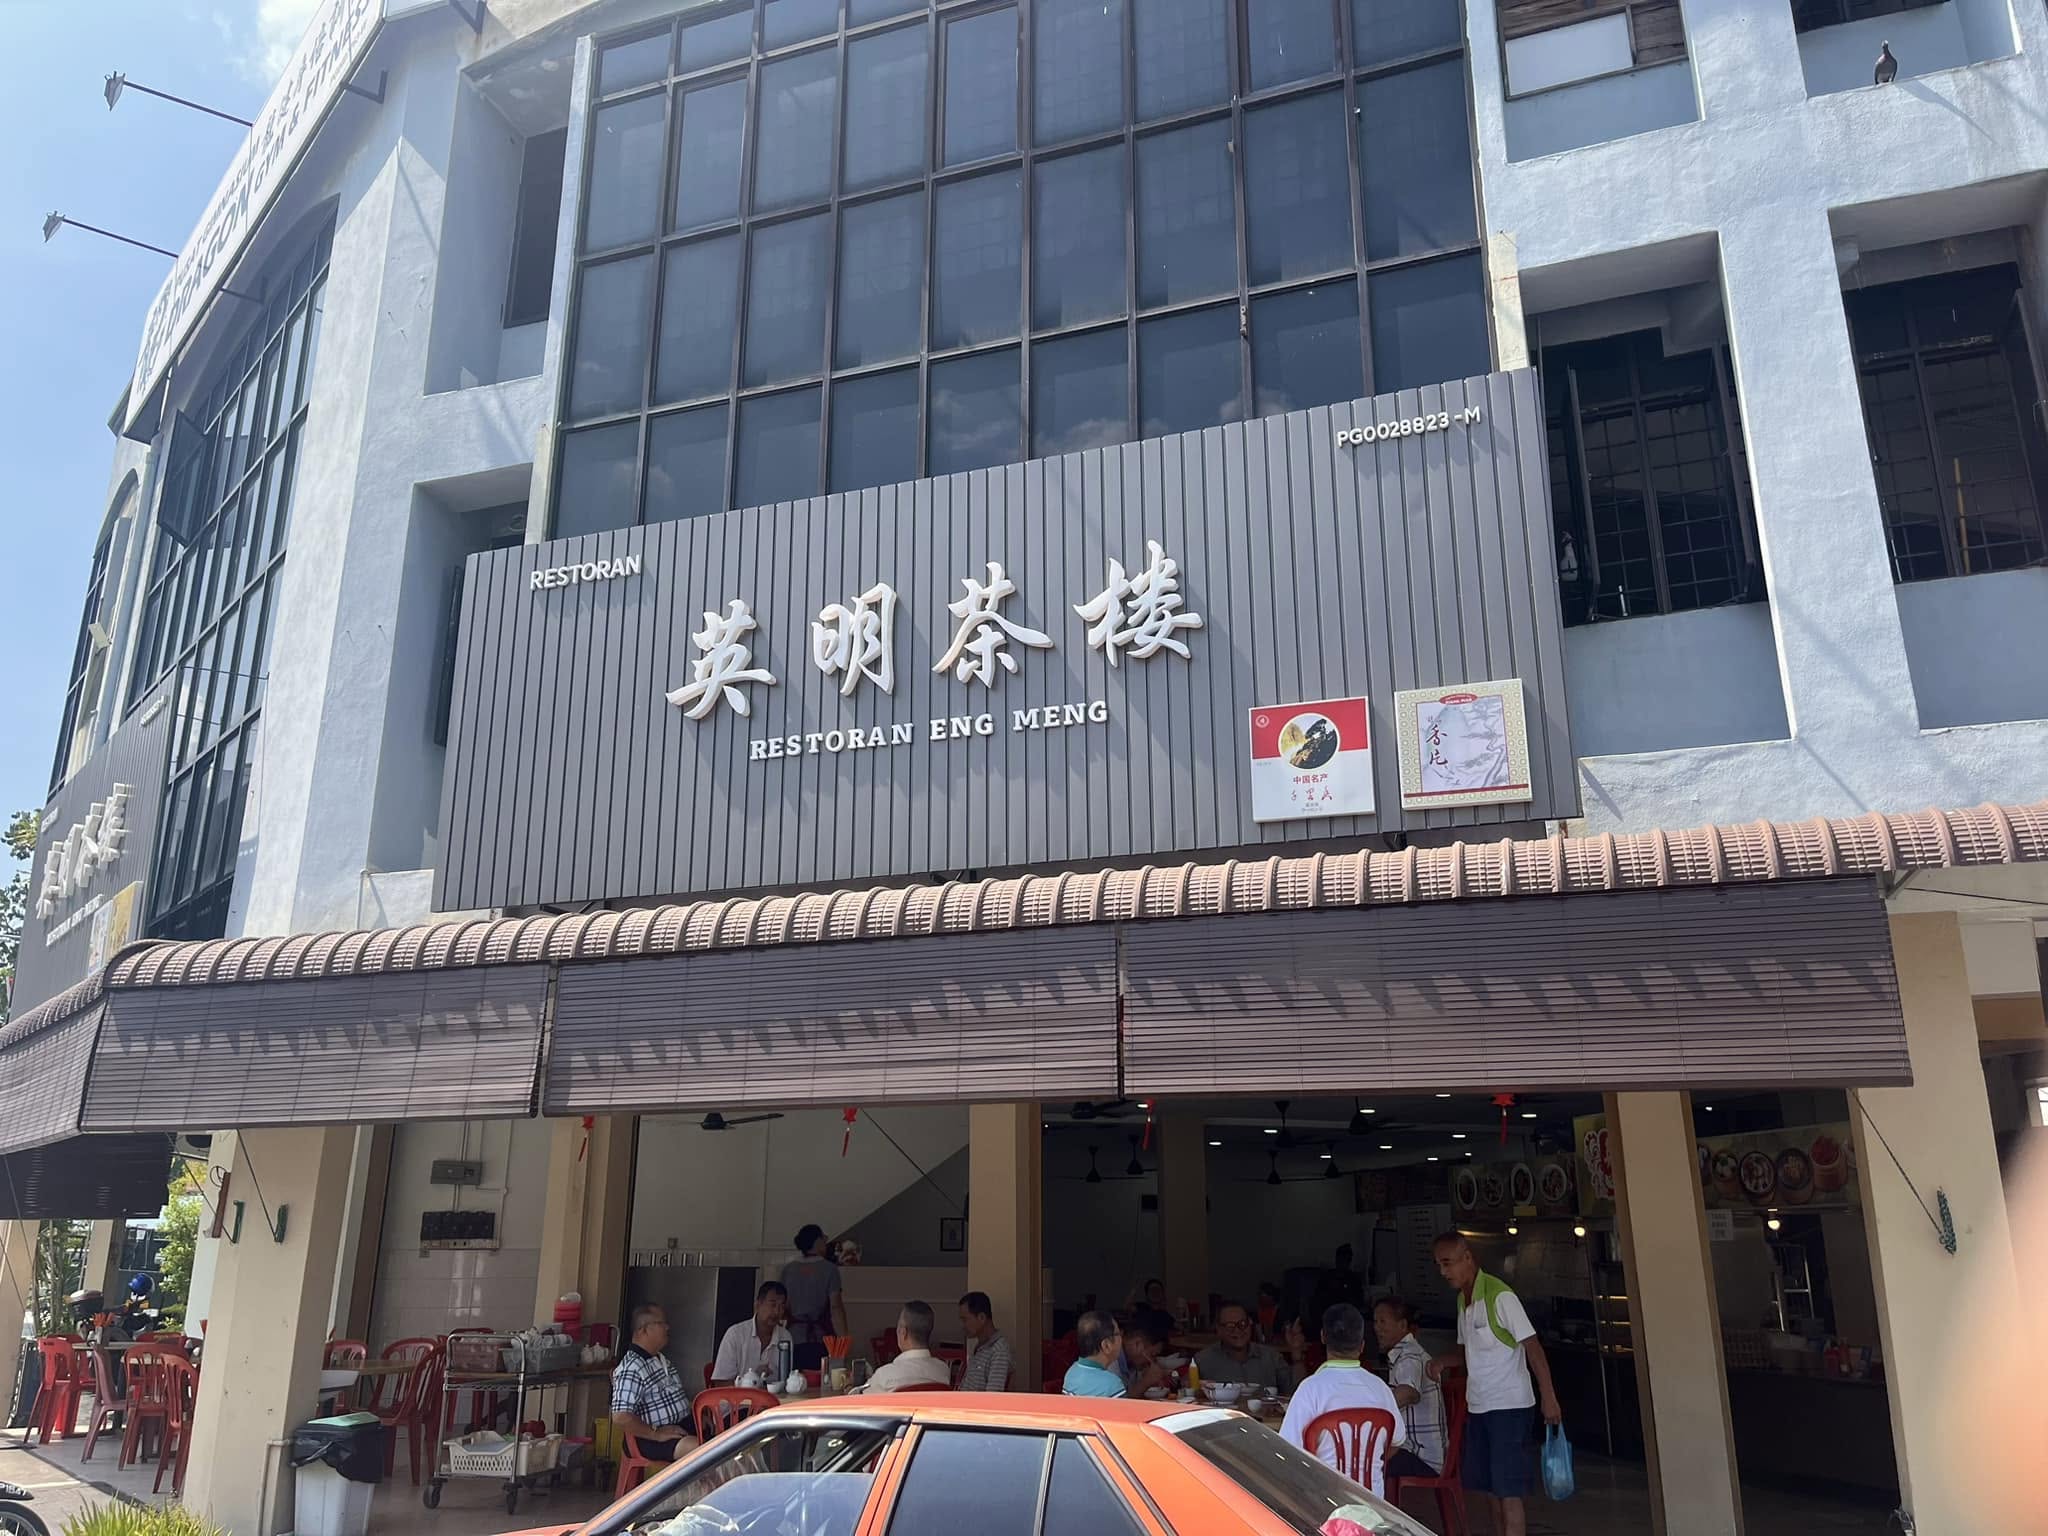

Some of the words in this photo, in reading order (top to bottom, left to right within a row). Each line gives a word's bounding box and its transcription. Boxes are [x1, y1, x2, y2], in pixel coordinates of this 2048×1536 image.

[254, 122, 287, 194] GYM
[530, 555, 641, 590] RESTORAN
[665, 539, 1204, 720] 英明茶楼
[750, 723, 914, 761] RESTORAN
[929, 713, 995, 741] ENG
[1012, 700, 1109, 732] MENG
[1293, 773, 1329, 784] 中国名产
